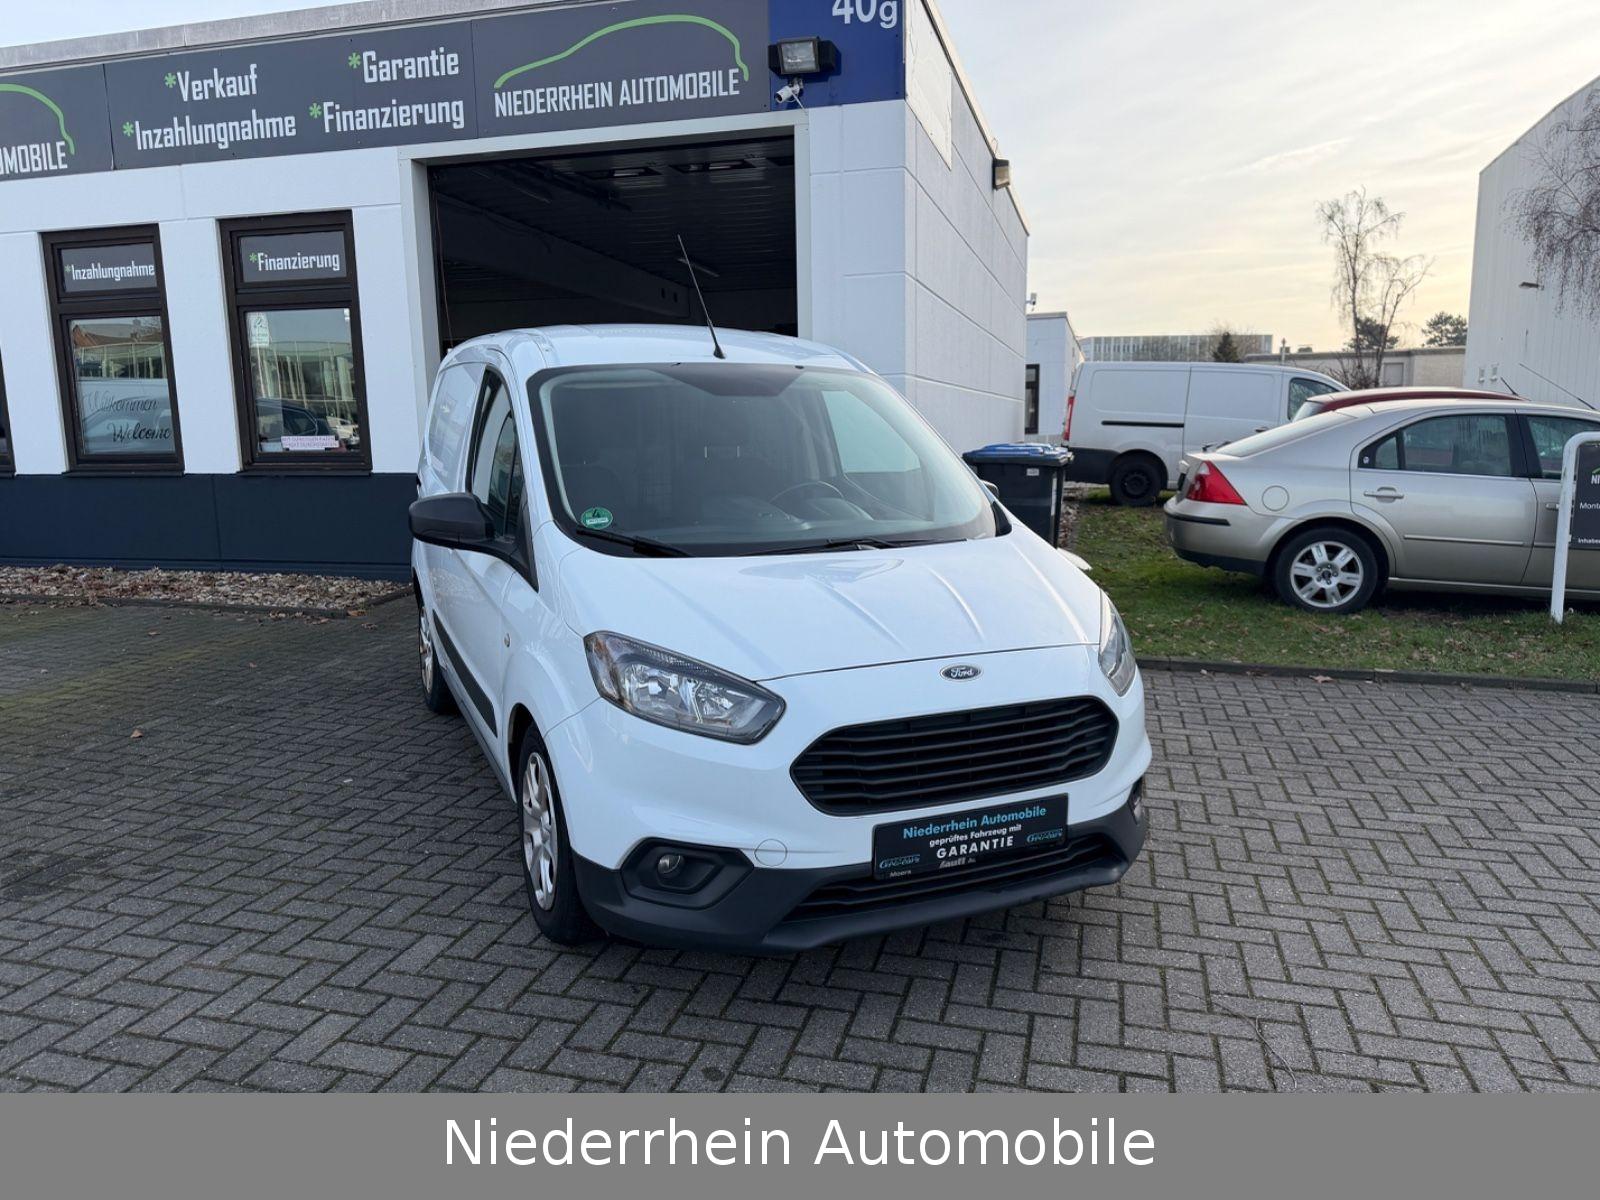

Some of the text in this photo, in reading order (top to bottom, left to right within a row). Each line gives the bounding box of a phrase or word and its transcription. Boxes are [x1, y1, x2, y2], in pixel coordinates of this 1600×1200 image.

[832, 0, 897, 29] 40g
[494, 67, 741, 118] NIEDERRHEIN AUTOMOBILE
[950, 666, 975, 678] Ford
[903, 805, 1048, 840] Niederrhein Automobile
[929, 824, 1022, 848] geprüftes Fahrzeug mit
[936, 835, 1014, 859] GARANTIE
